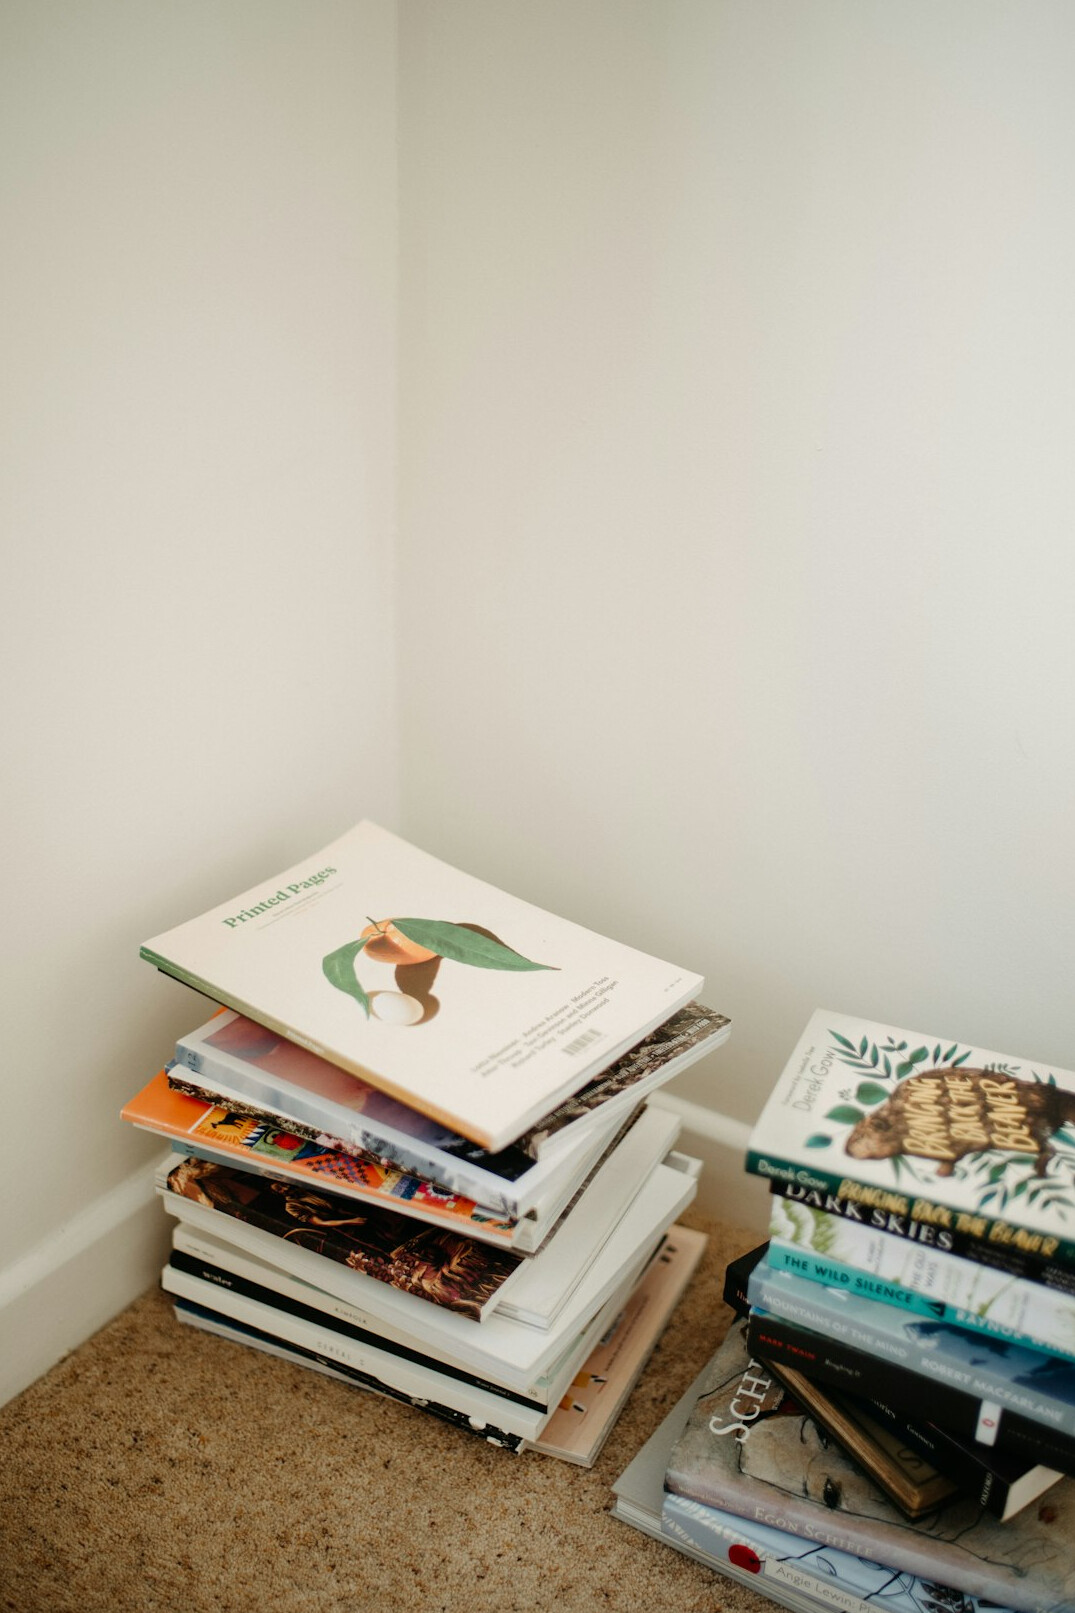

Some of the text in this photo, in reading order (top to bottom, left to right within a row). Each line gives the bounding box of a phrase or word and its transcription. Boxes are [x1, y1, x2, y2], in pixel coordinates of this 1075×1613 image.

[221, 890, 291, 929] Printed
[286, 865, 338, 895] Pages
[567, 1008, 579, 1019] and
[595, 980, 620, 998] Gilligan
[570, 985, 598, 1003] Modern
[593, 976, 609, 987] Toss
[791, 1049, 836, 1113] Derek Gow
[943, 1074, 990, 1146] BACK THE
[902, 1078, 958, 1161] BRINGING
[979, 1077, 1041, 1153] BEAVER
[757, 1158, 829, 1191] Derek Gow
[785, 1182, 955, 1252] DARK SKIES
[836, 1178, 1061, 1258] BRINGING BACK THE BEAVER
[783, 1253, 914, 1304] THE WILD SILENCE
[924, 1259, 939, 1288] WAYS
[758, 1333, 817, 1361] MARK TWAIN
[762, 1293, 831, 1329] MOUNTAINS
[831, 1321, 849, 1335] OF
[850, 1328, 875, 1345] THE
[874, 1338, 908, 1359] MIND
[955, 1309, 1023, 1341] RAYNOR
[920, 1356, 1064, 1423] ROBERT MACFARLANE
[753, 1505, 874, 1558] EGON SCHIELE
[775, 1565, 812, 1590] Angie
[815, 1579, 855, 1609] Lewin:
